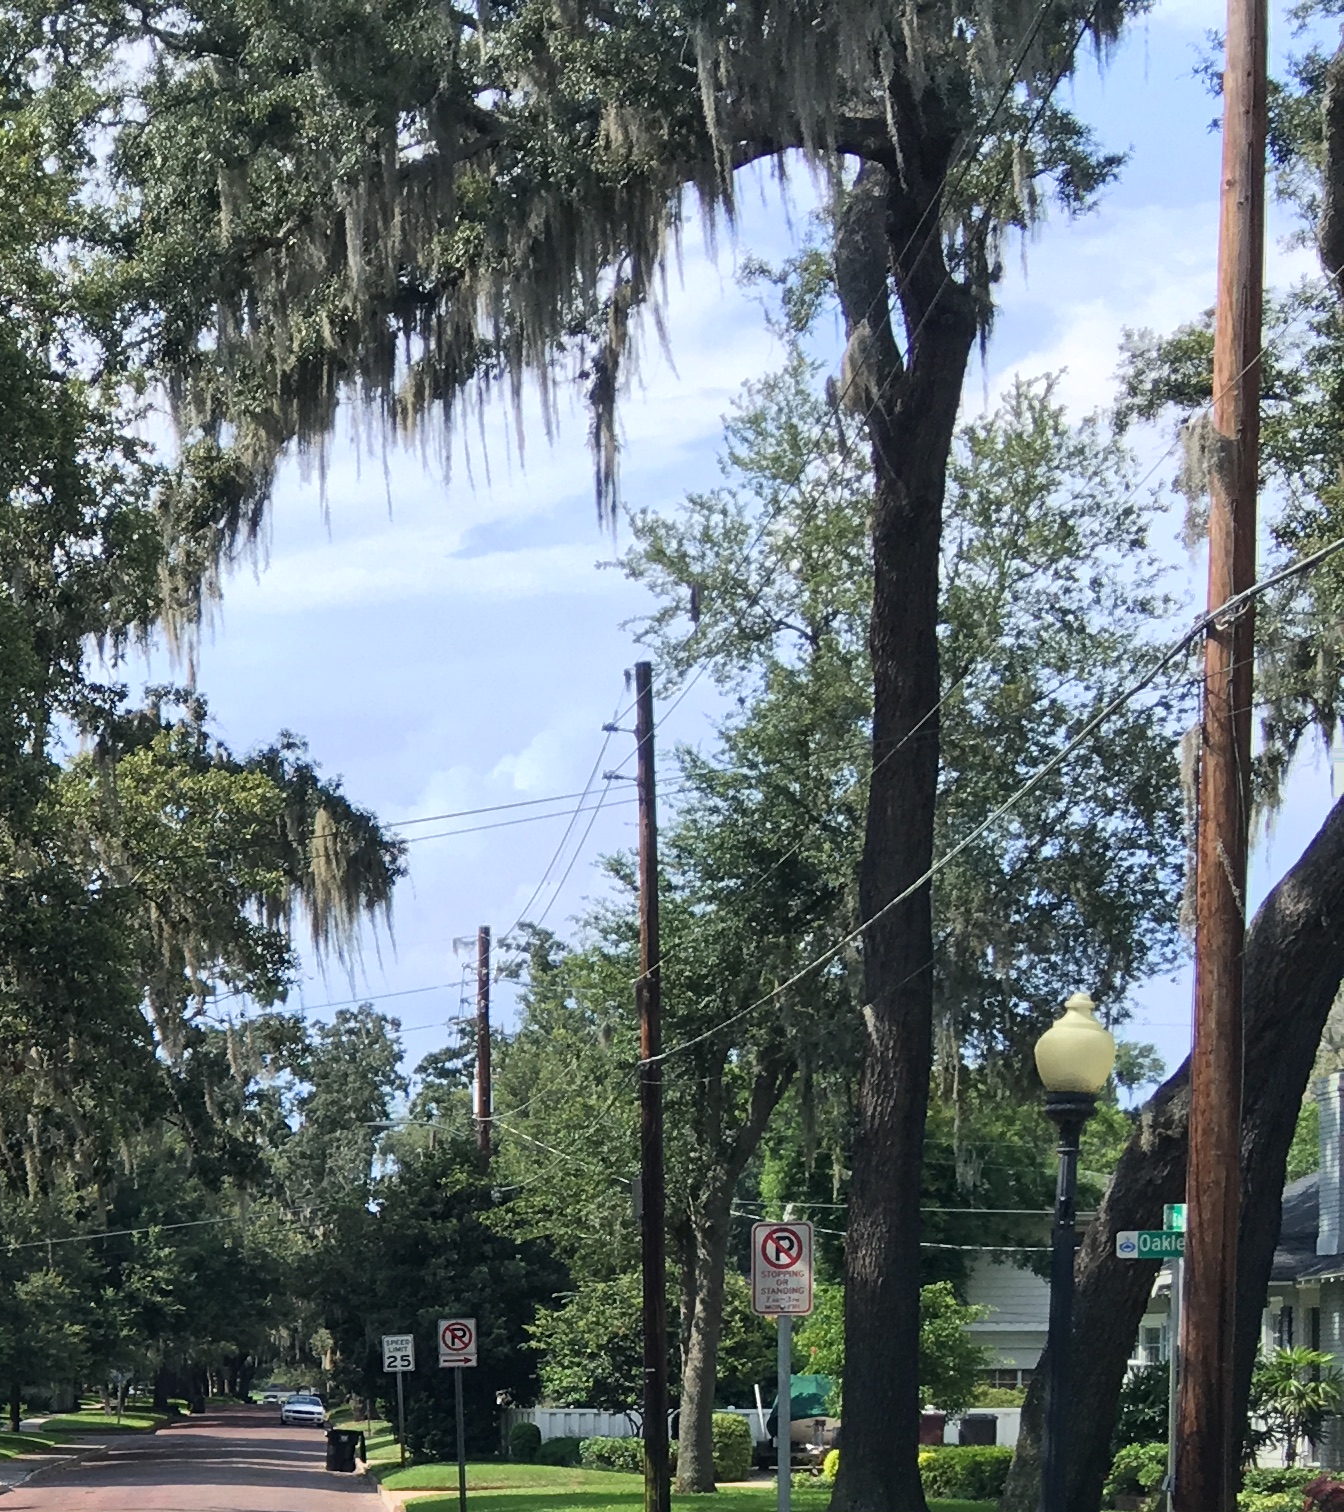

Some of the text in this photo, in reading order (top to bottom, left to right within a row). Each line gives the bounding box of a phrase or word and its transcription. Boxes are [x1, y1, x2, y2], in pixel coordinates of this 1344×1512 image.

[760, 1270, 805, 1279] STOPPING
[776, 1279, 789, 1287] OR
[760, 1287, 805, 1296] STANDING
[386, 1354, 412, 1369] 25
